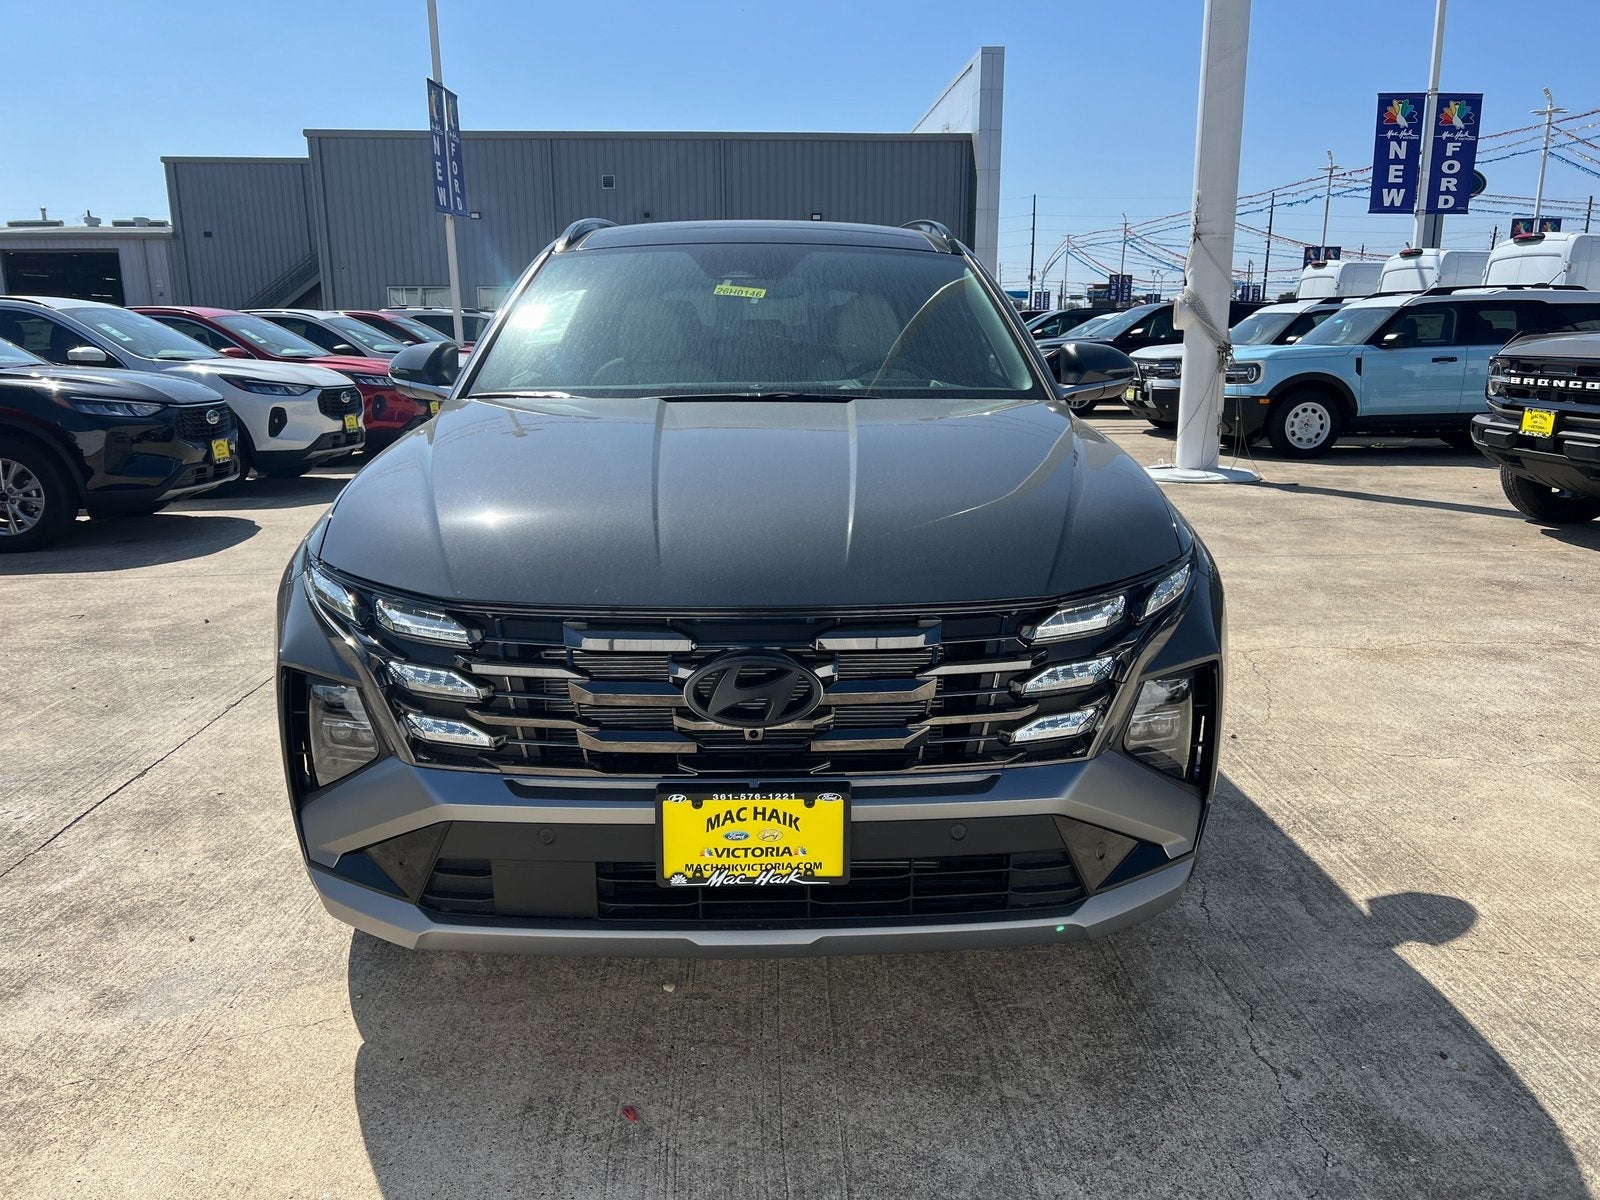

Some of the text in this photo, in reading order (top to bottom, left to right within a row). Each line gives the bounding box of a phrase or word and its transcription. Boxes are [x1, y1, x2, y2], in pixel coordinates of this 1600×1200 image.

[433, 135, 446, 206] NEW
[451, 142, 463, 210] FORD
[1382, 141, 1408, 207] NEW
[1437, 142, 1462, 209] FORD
[716, 287, 763, 297] 26H0146
[1510, 377, 1600, 390] BRONCO
[706, 806, 801, 833] MAC HAIK
[714, 847, 794, 859] VICTORIA
[684, 861, 823, 872] MACHAIKVICTORIA.COM
[705, 868, 805, 887] Mac Haik
